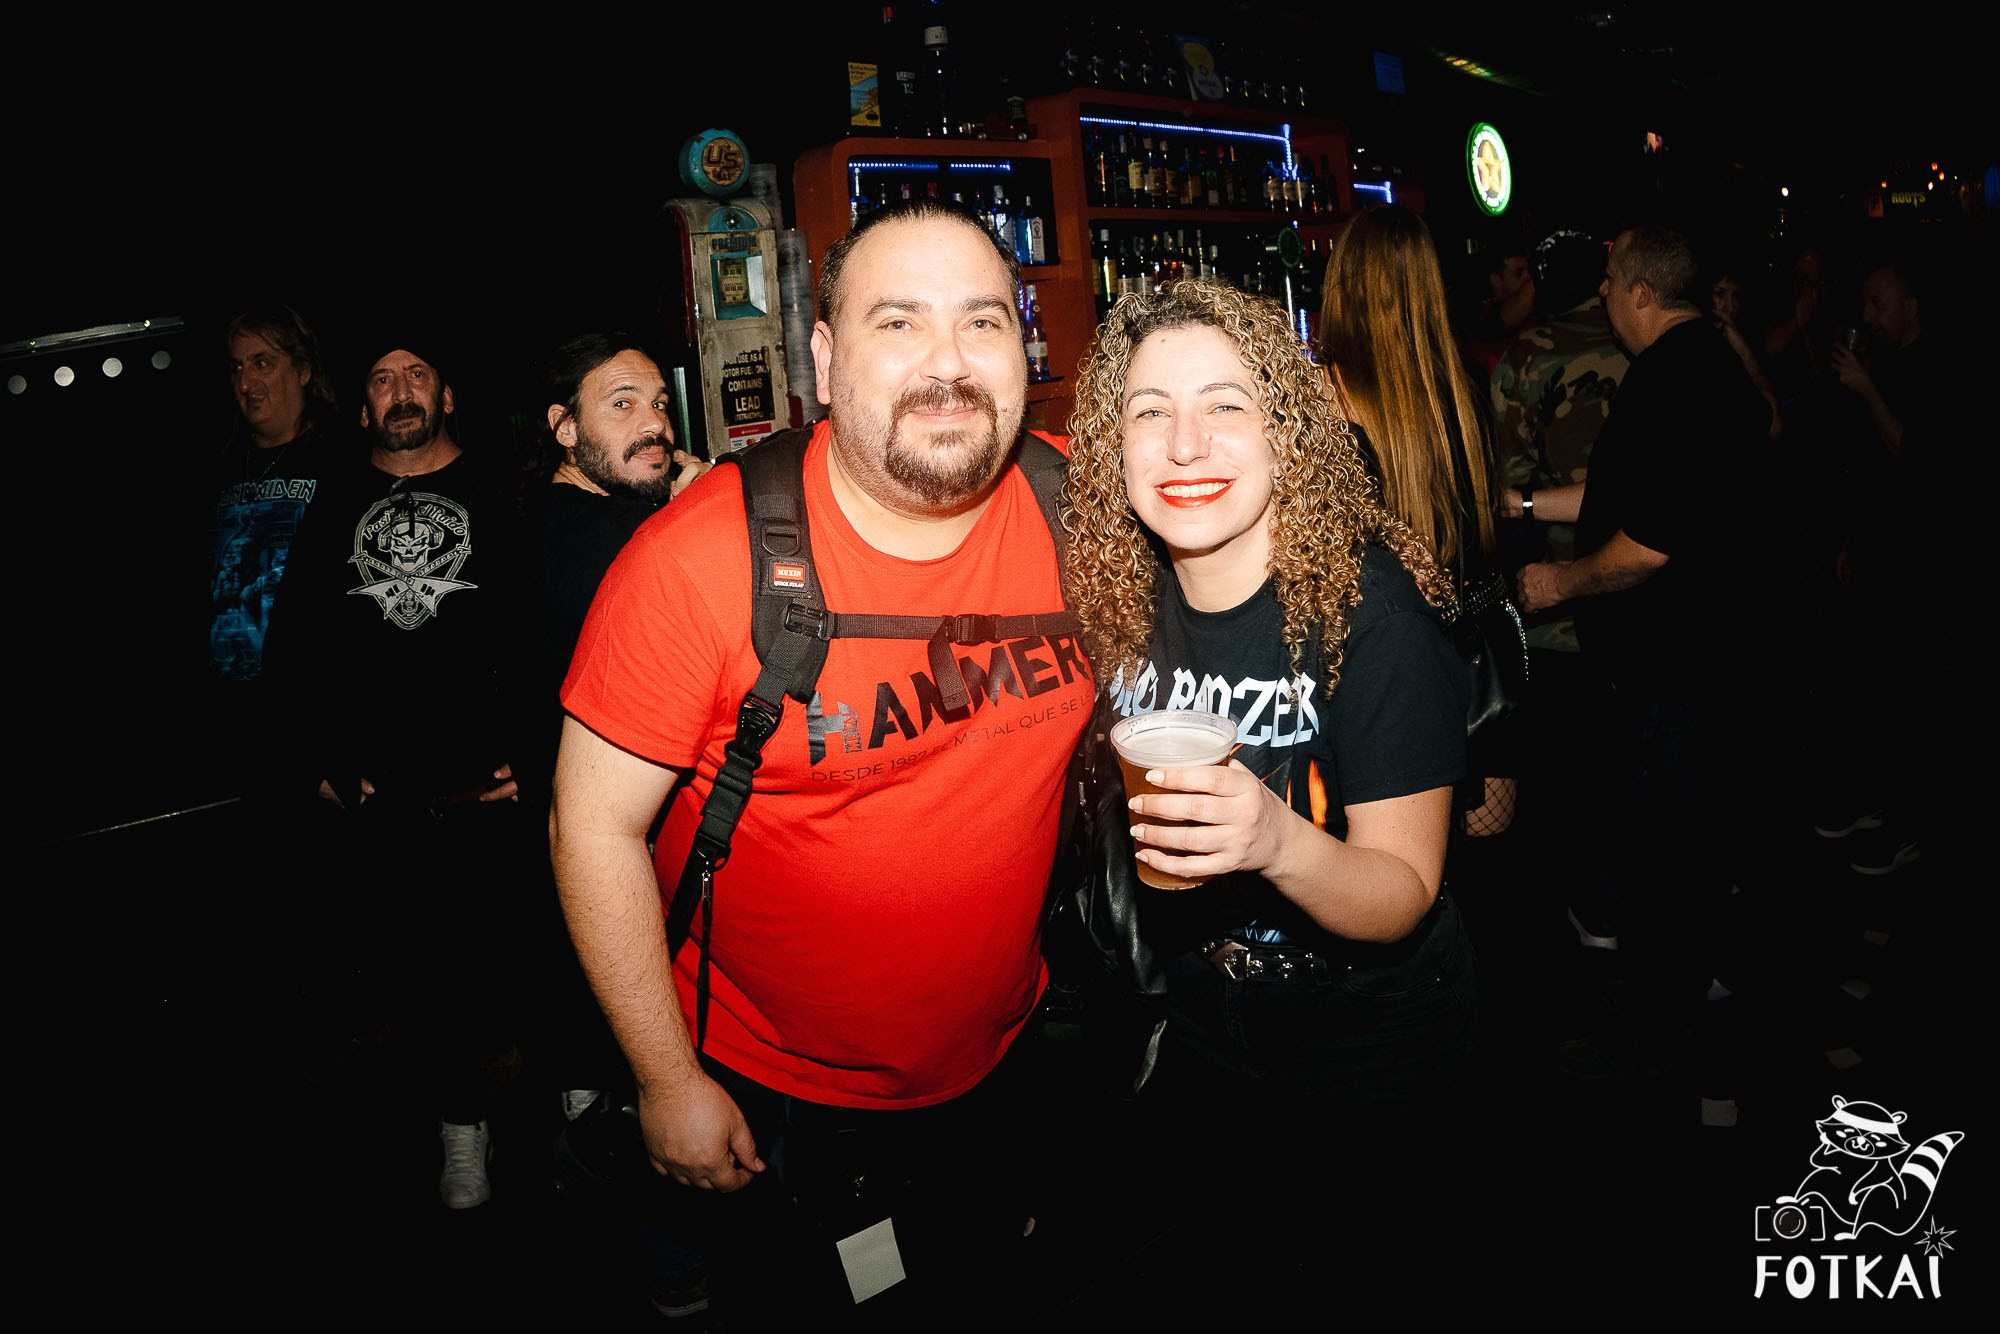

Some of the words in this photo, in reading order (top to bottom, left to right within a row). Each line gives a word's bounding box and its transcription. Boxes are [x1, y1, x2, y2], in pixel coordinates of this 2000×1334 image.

[728, 378, 763, 392] CONTAINS
[735, 395, 761, 412] LEAD
[812, 762, 883, 782] DESDE
[954, 723, 1016, 748] METAL
[1020, 707, 1056, 729] QUE
[1061, 698, 1078, 715] SE
